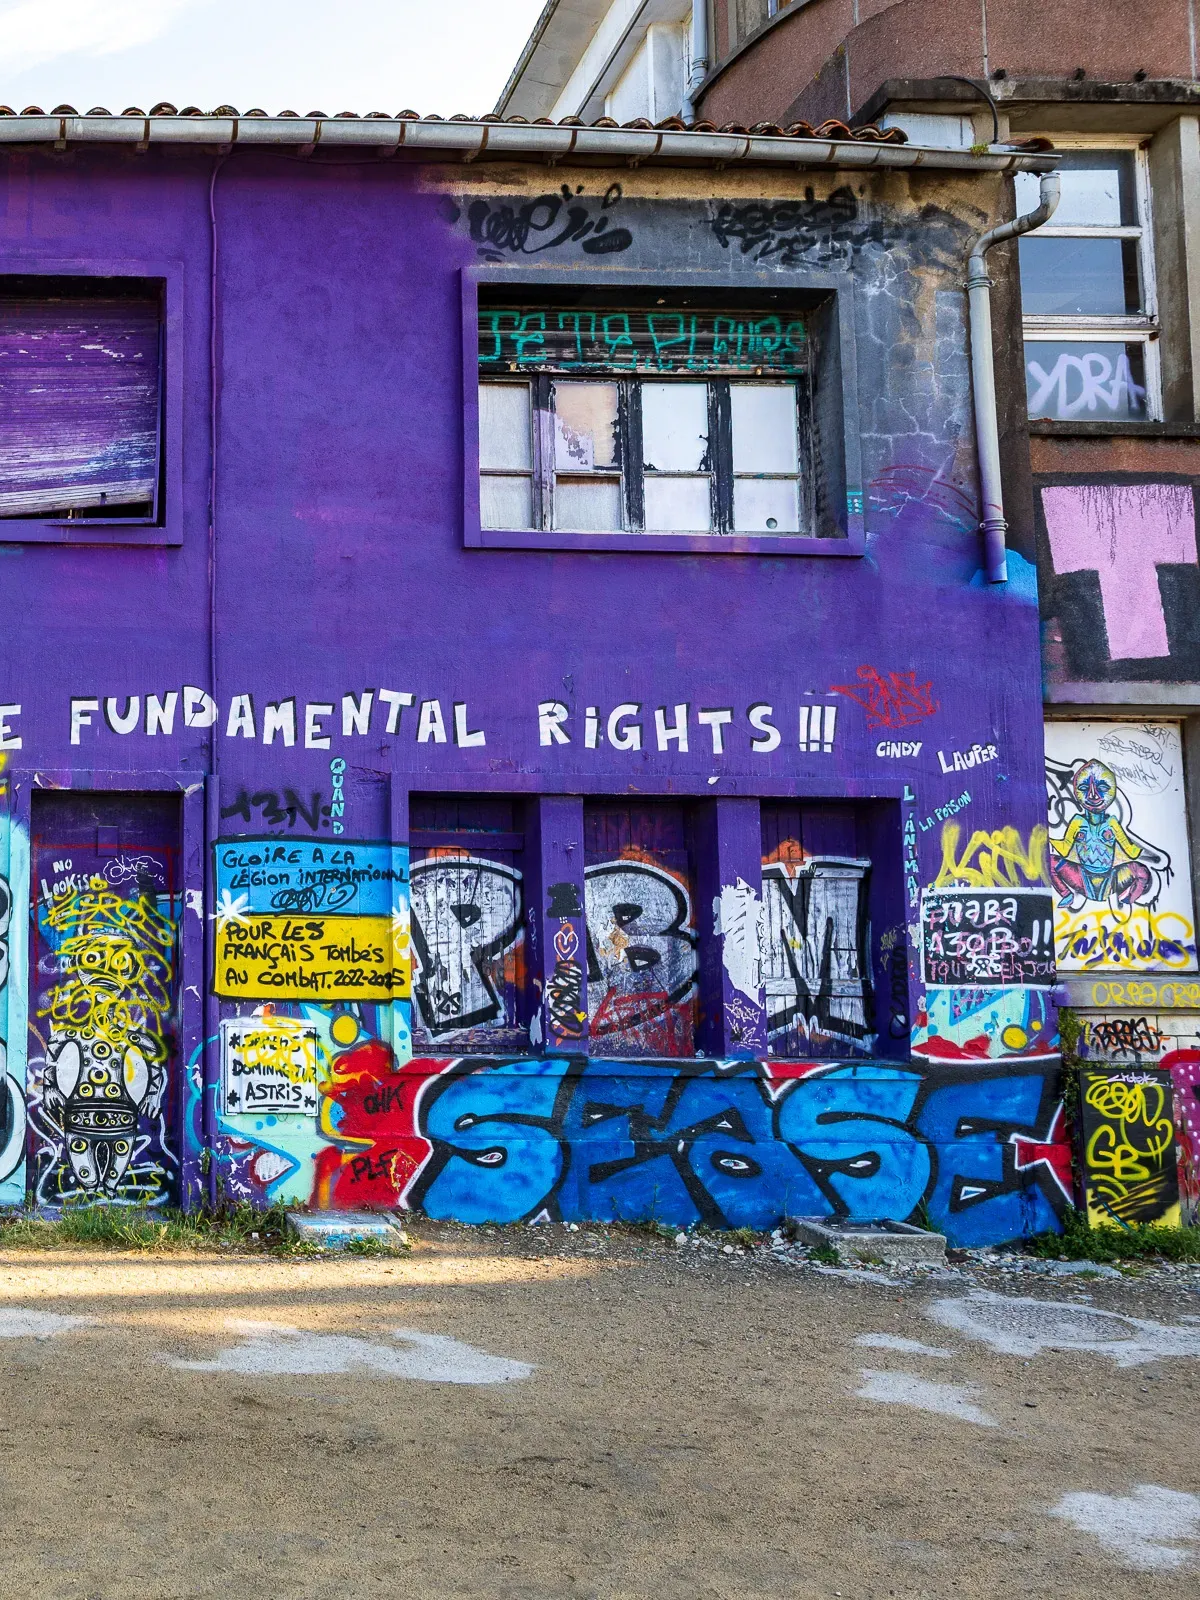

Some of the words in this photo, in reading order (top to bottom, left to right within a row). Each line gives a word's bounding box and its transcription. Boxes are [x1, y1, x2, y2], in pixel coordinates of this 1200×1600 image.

[68, 684, 486, 750] FUNDAMENTAL
[937, 742, 999, 774] LAUPER
[330, 757, 347, 835] QUAND
[919, 816, 936, 832] LA
[53, 859, 73, 873] NO
[312, 848, 325, 863] A
[331, 850, 356, 866] LA
[226, 922, 276, 941] POUR
[282, 921, 325, 941] LES
[225, 968, 249, 986] AU
